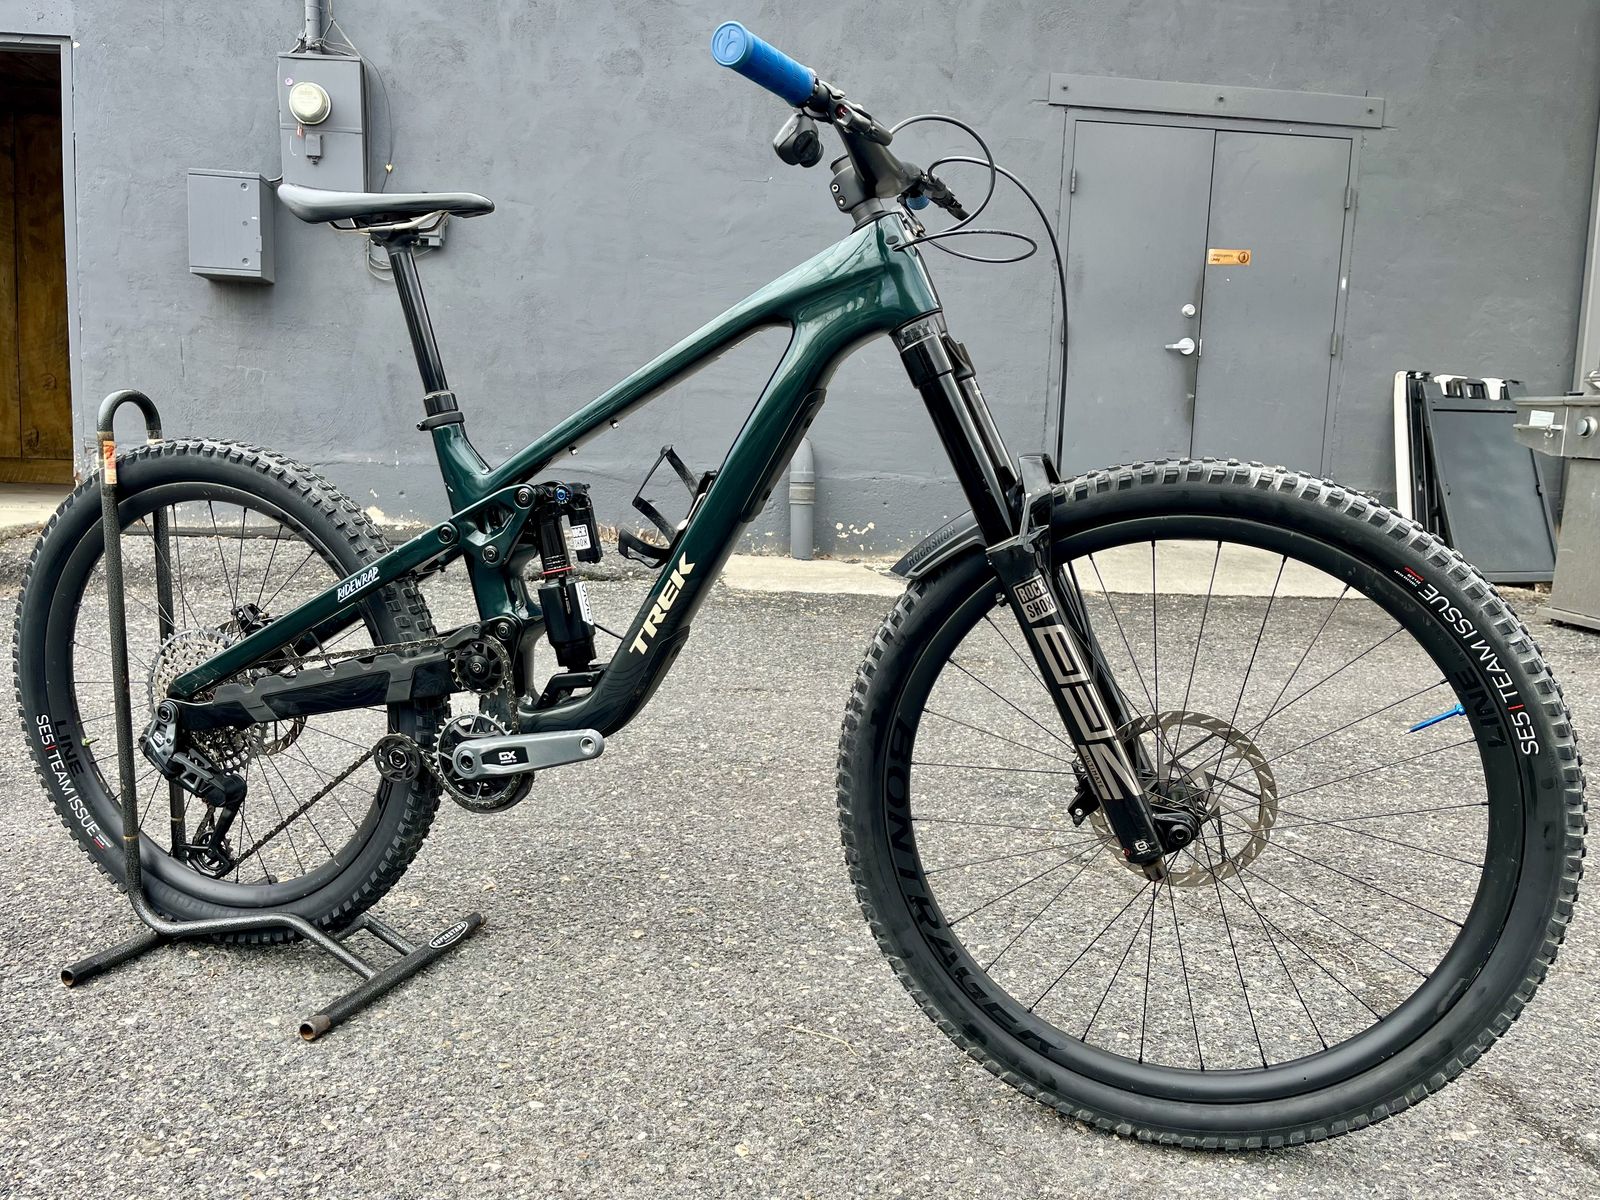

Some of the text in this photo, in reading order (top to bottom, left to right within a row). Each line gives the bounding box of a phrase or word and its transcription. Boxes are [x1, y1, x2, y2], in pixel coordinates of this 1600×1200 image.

[336, 566, 380, 602] RIDEWRAP
[628, 551, 696, 656] TREK
[1017, 578, 1048, 603] ROCK
[1026, 595, 1055, 618] SHOX
[1417, 583, 1478, 639] ISSUE
[1471, 639, 1519, 704] TEAM
[1453, 665, 1508, 748] LINE
[1510, 711, 1540, 755] SE5
[36, 714, 101, 837] SE5 TEAM ISSUE
[54, 720, 85, 778] LINE
[498, 750, 517, 761] GX
[1084, 754, 1105, 790] ULTIMATE
[886, 714, 1068, 1055] BONTRAGER
